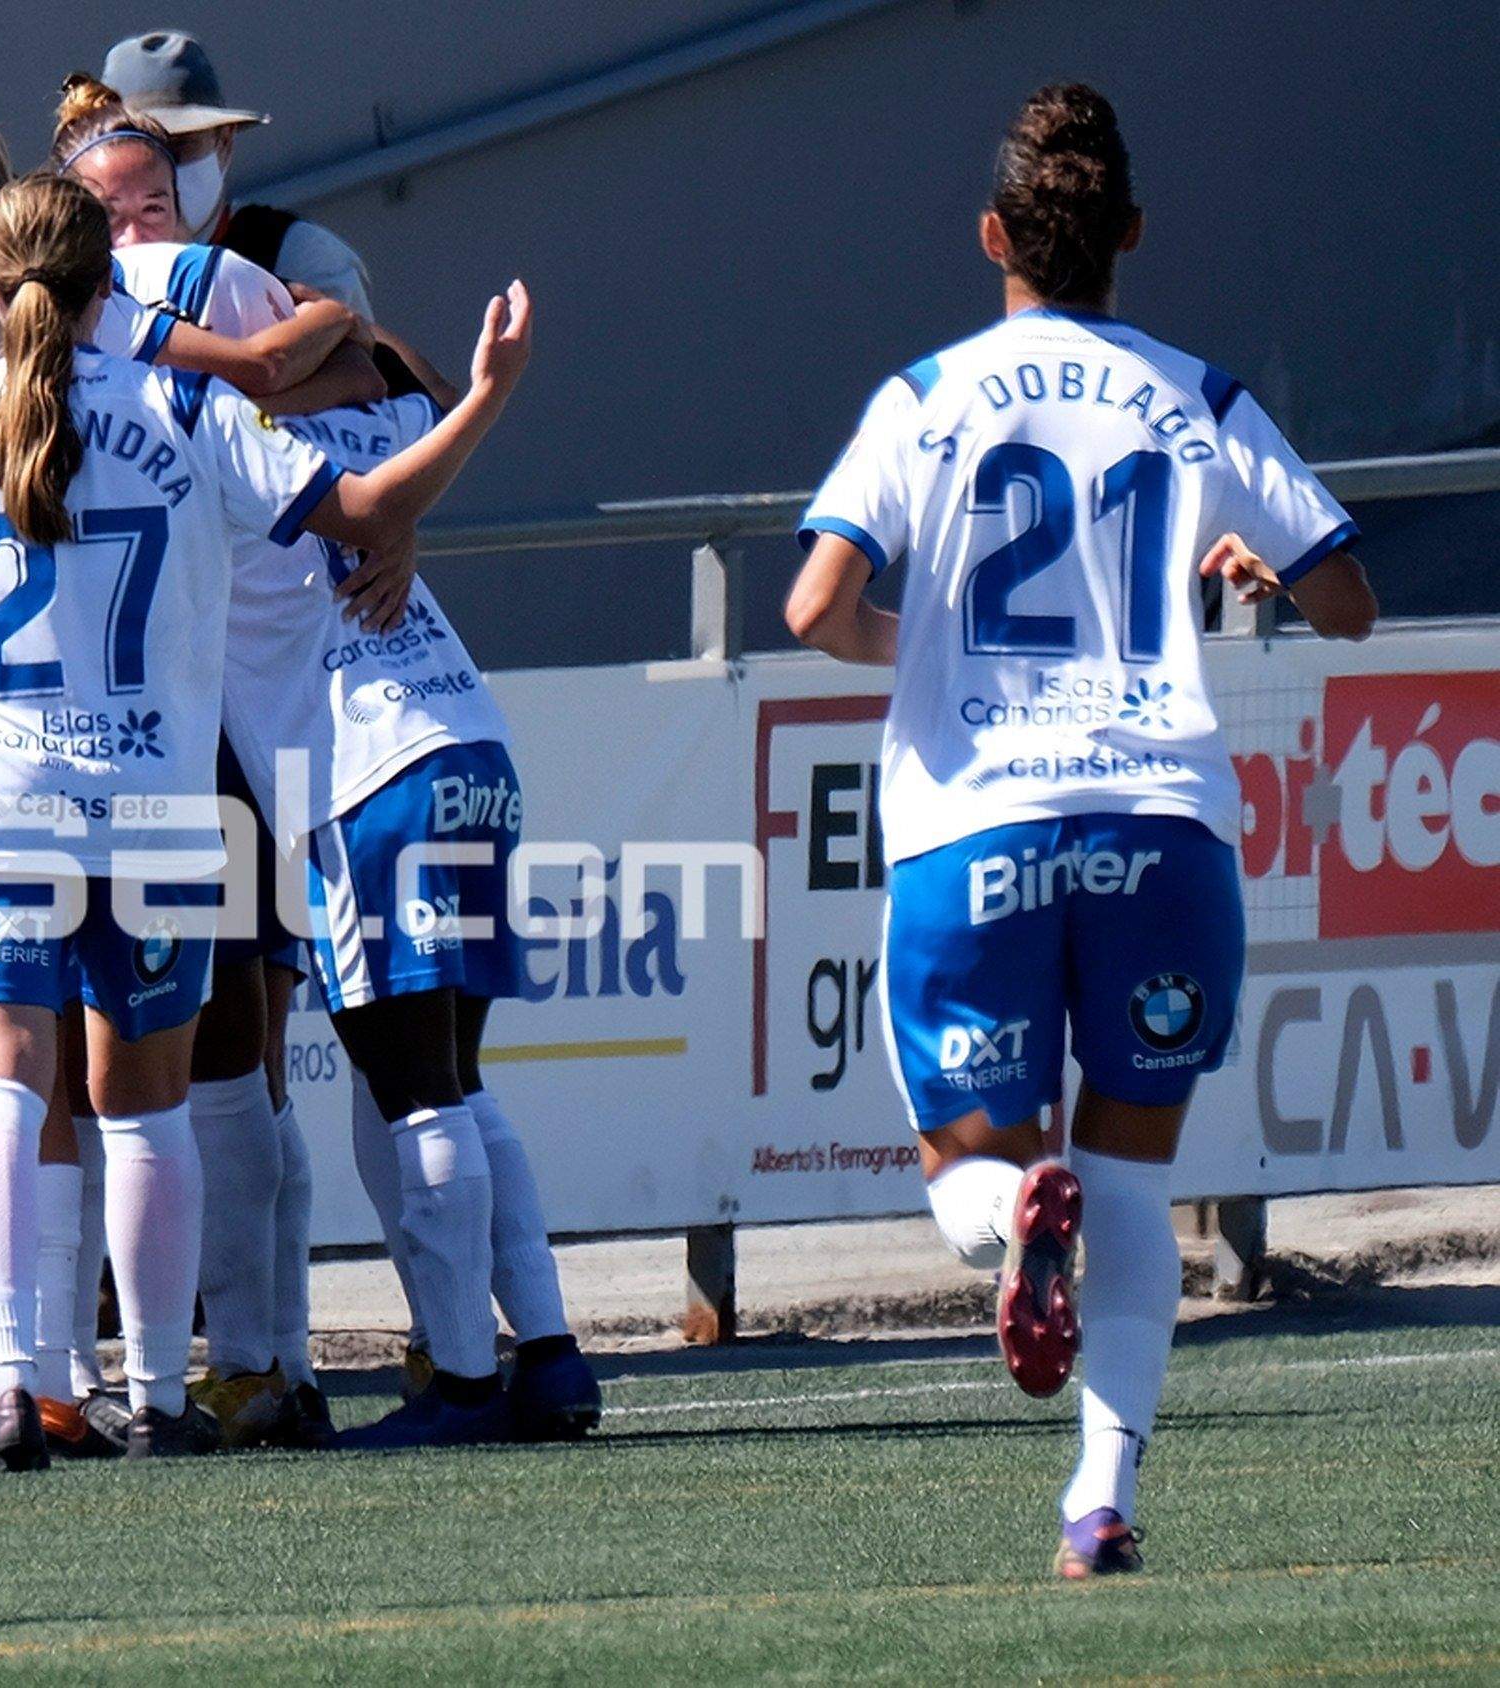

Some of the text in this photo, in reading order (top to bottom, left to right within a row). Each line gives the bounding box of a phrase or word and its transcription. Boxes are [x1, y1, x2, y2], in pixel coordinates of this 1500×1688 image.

[978, 361, 1216, 464] DOBLADO
[966, 442, 1175, 665] 21
[41, 710, 112, 736] Islas
[1007, 750, 1181, 783] cajasiete
[15, 789, 169, 824] cajasiete
[968, 839, 1162, 926] Binter
[939, 1018, 1031, 1070] DXT
[941, 1060, 1028, 1091] TENERIFE
